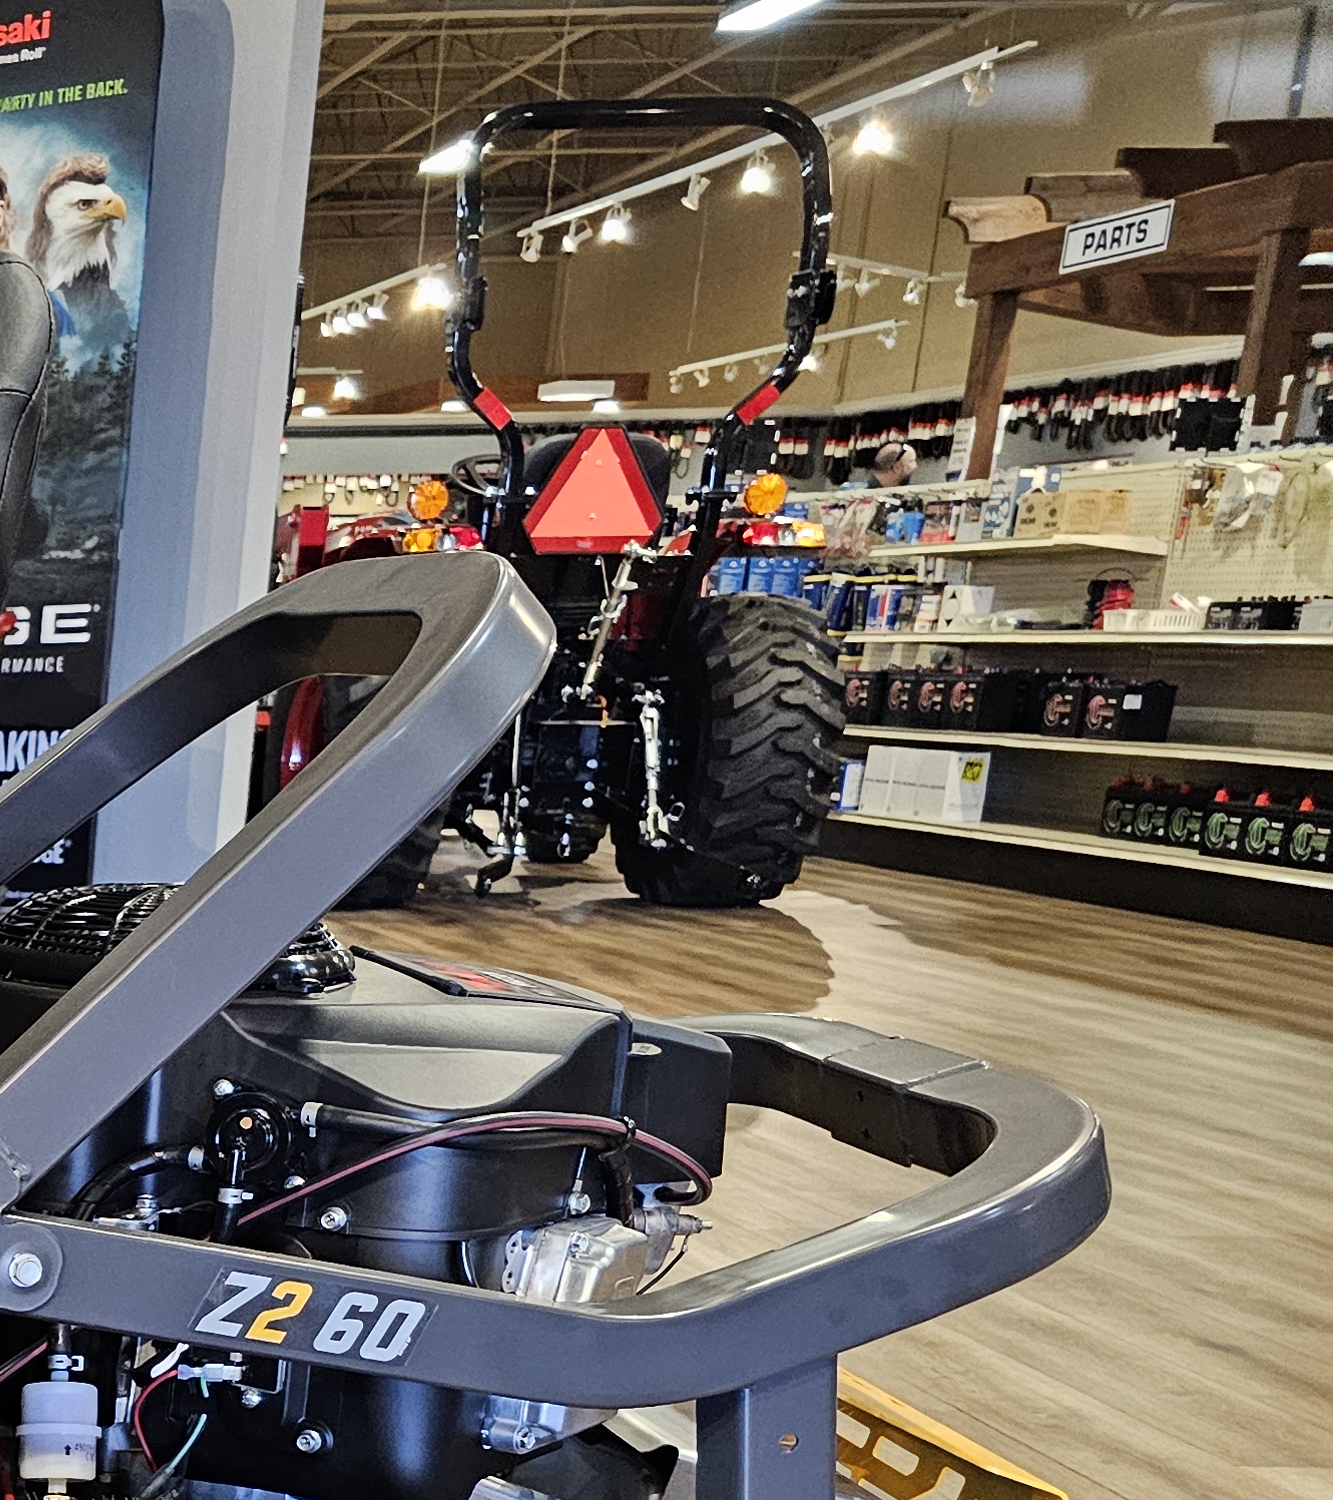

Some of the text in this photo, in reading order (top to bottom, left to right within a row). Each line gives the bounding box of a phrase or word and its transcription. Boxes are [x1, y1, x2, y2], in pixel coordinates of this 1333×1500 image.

[38, 90, 54, 106] IN
[57, 85, 83, 103] THE
[86, 79, 129, 99] BACK.
[1081, 217, 1150, 257] PARTS
